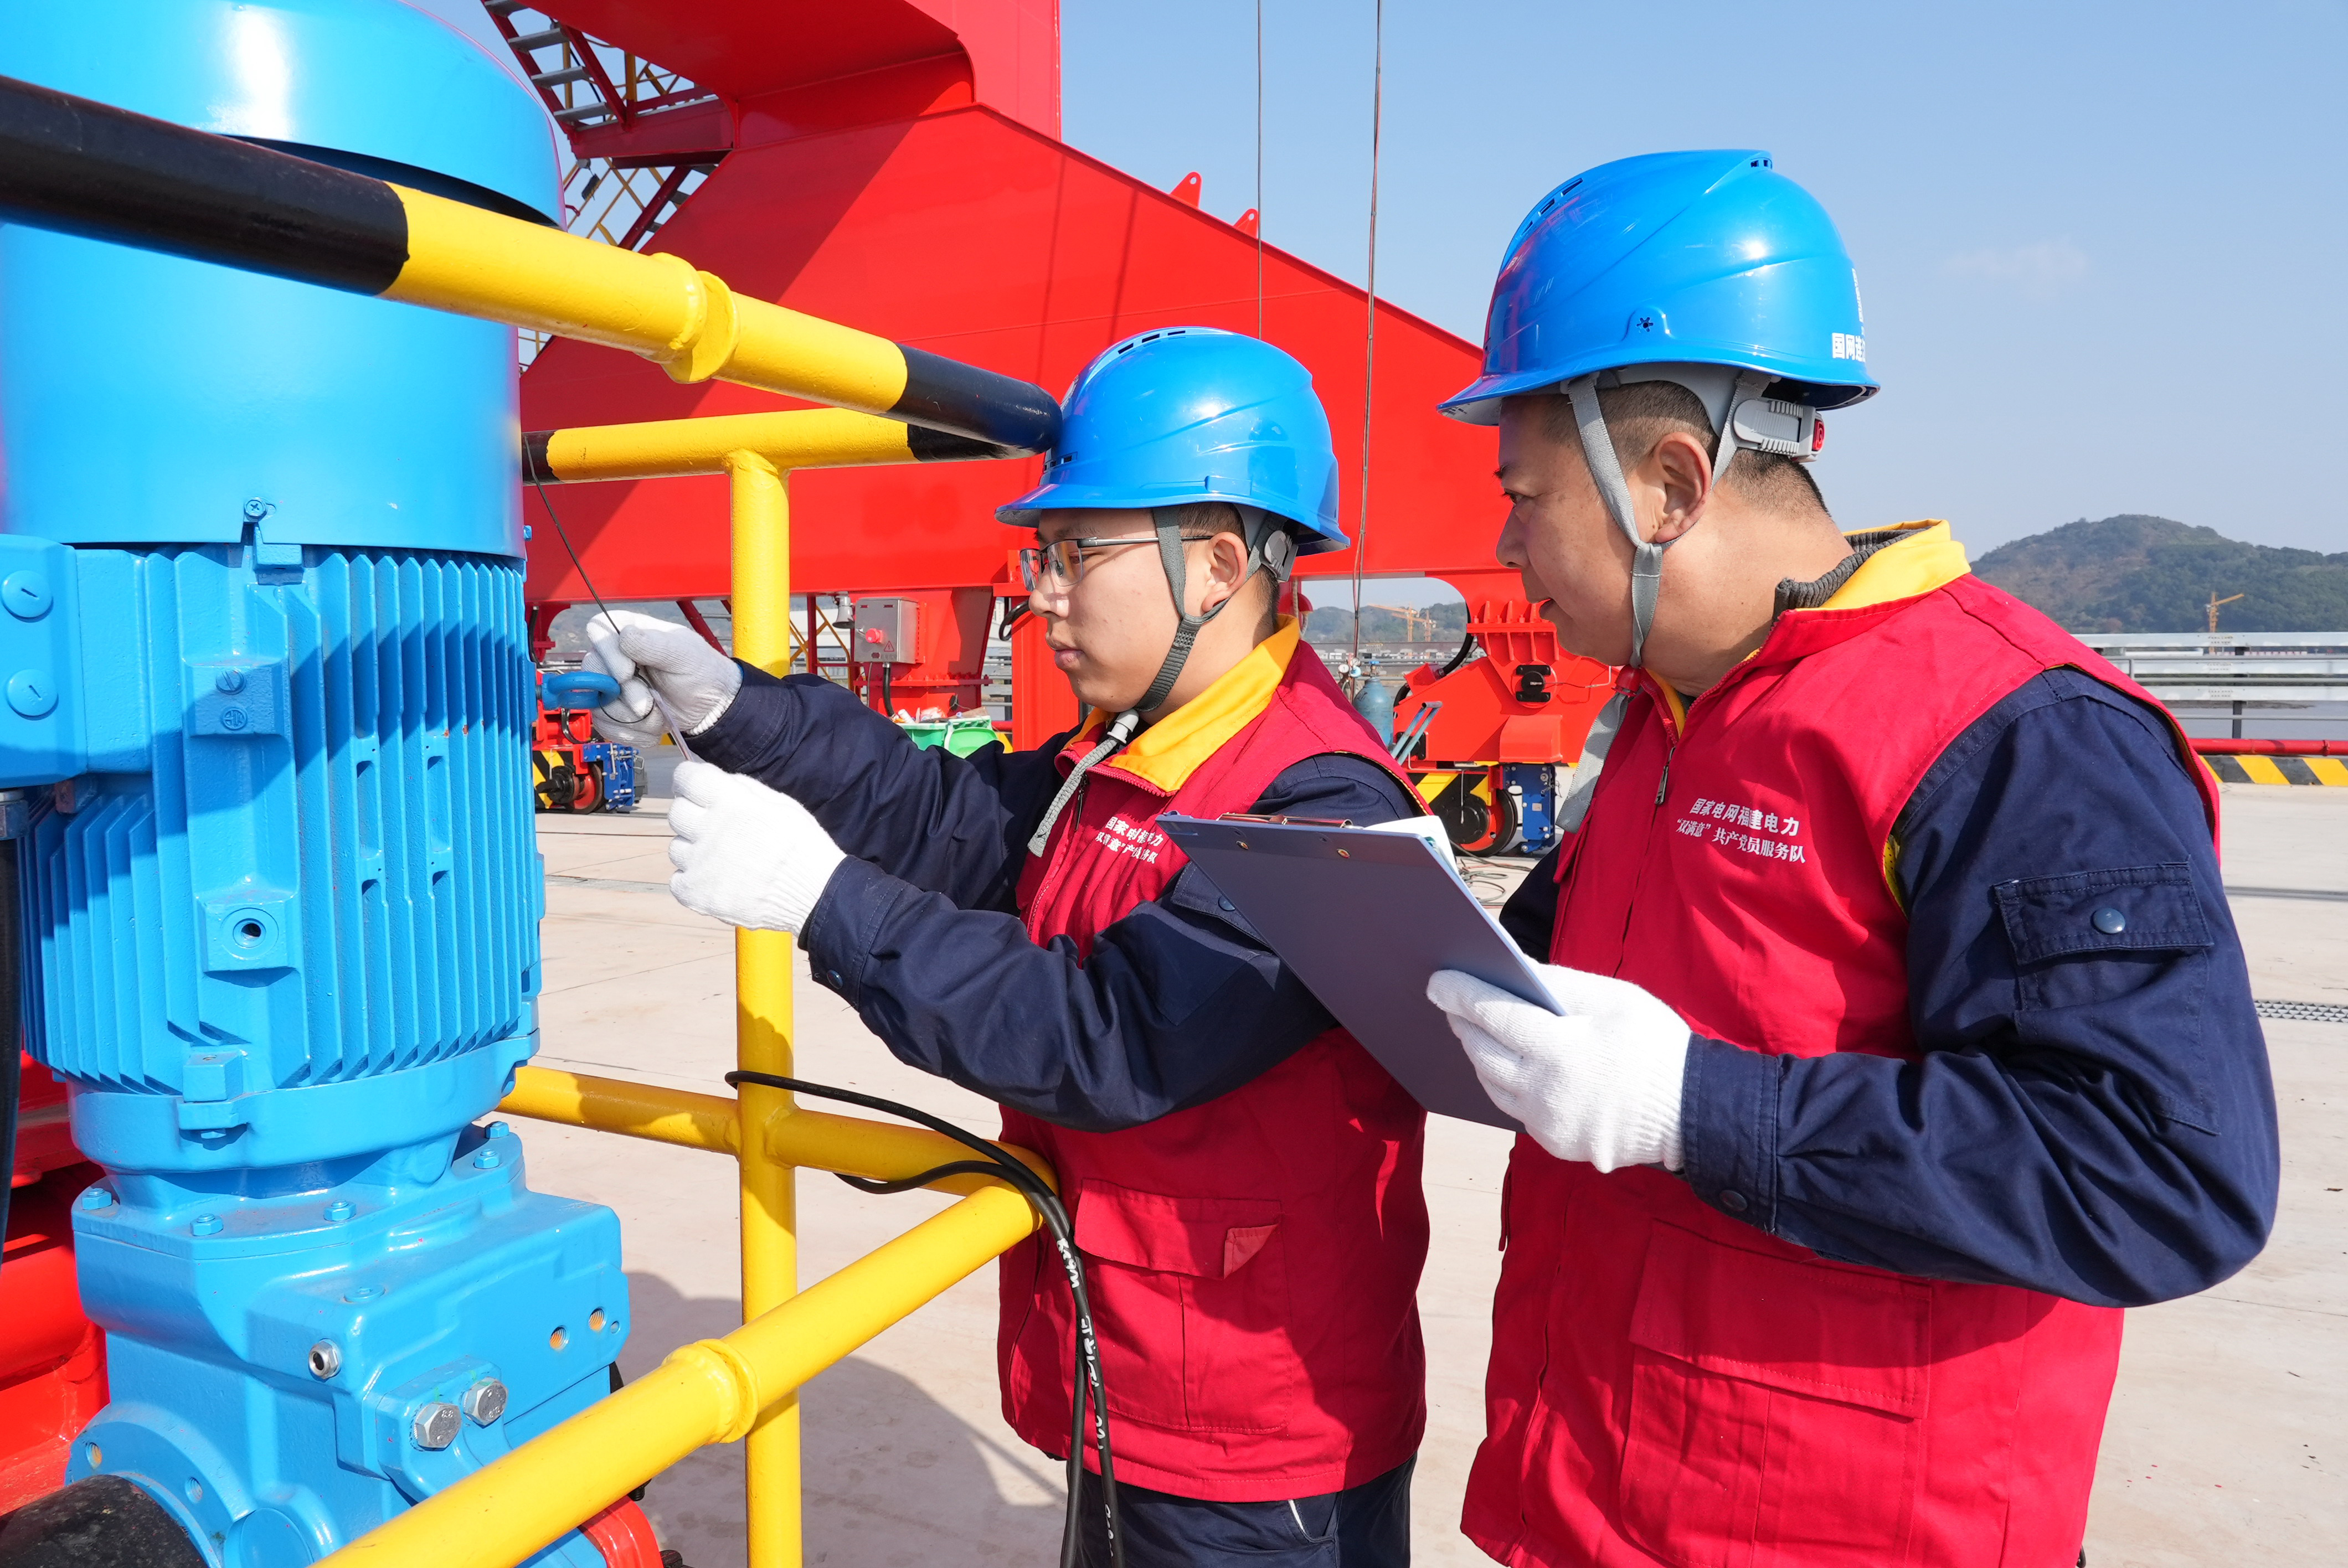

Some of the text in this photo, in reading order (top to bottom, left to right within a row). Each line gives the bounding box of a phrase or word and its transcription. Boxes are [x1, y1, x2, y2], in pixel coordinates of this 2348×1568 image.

[1689, 798, 1800, 837] 国家电网福建电力
